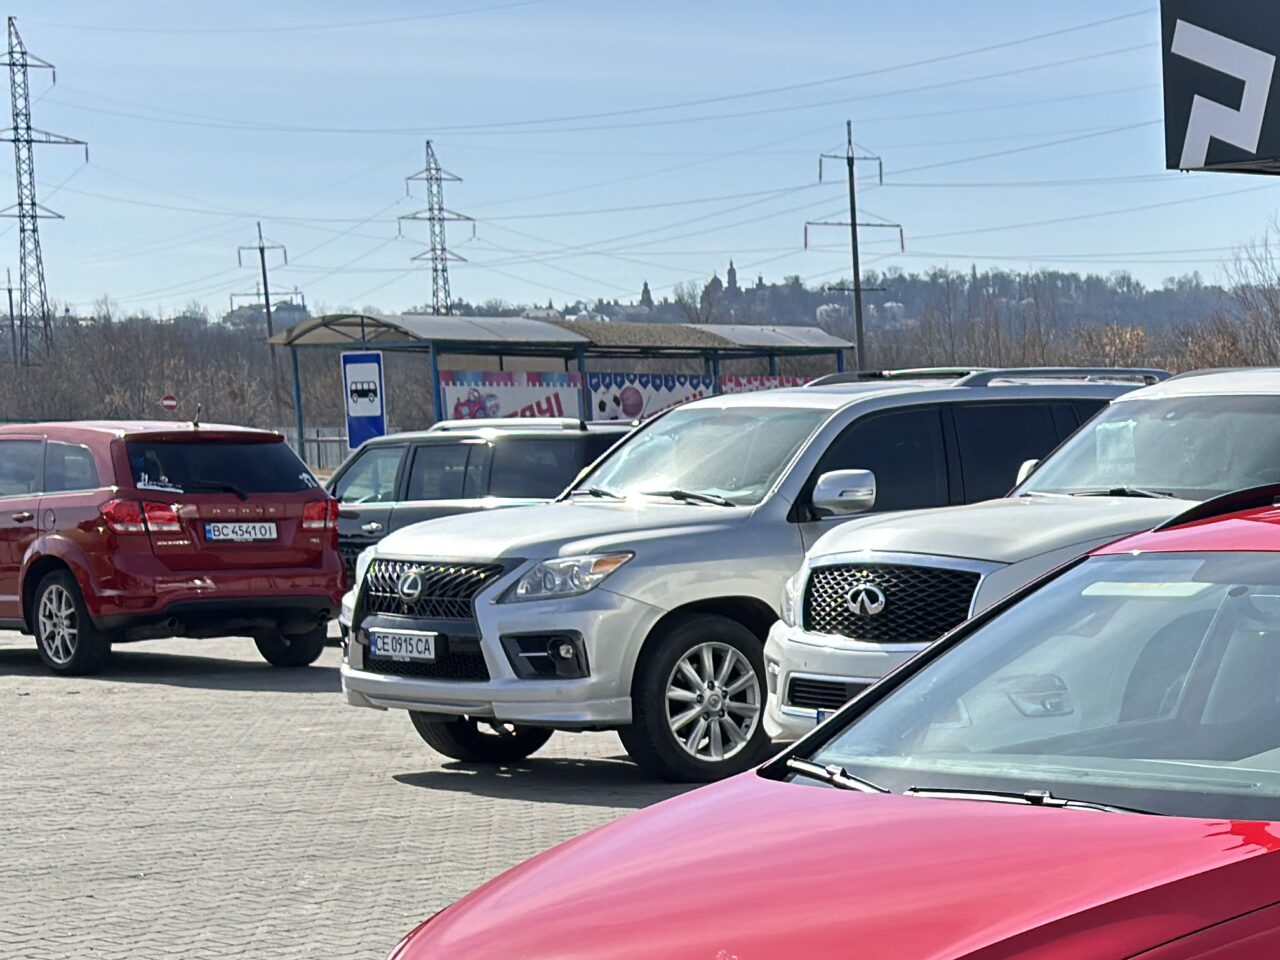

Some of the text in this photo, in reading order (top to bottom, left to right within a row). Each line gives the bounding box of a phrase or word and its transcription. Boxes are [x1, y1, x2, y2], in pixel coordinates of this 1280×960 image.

[212, 525, 230, 537] BC
[231, 525, 257, 537] 4541
[376, 635, 432, 656] CE 0915 CA
